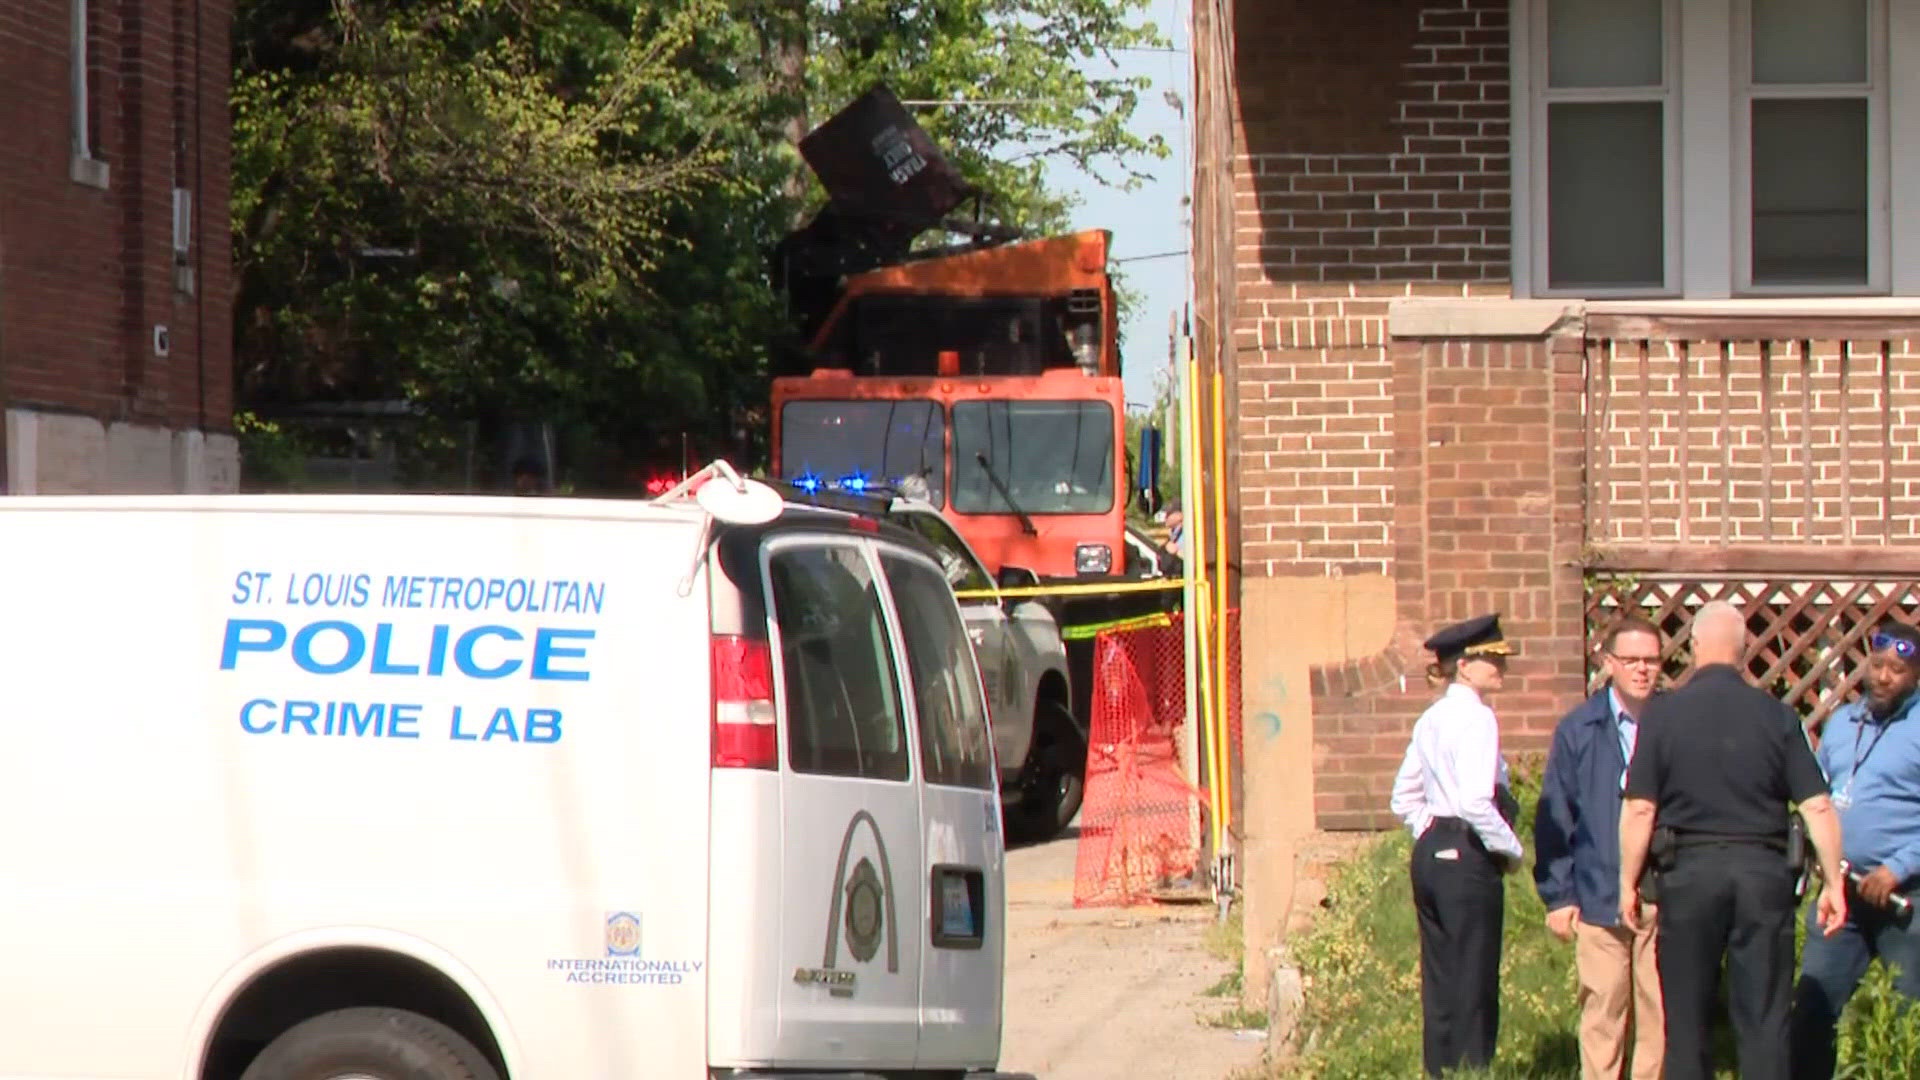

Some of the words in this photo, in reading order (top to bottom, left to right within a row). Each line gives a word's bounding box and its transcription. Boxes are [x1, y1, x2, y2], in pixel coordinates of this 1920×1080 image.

[232, 571, 272, 605] ST.
[285, 573, 371, 607] LOUIS
[381, 575, 606, 614] METROPOLITAN
[219, 618, 597, 682] POLICE
[239, 698, 423, 739] CRIME
[449, 705, 564, 744] LAB
[547, 959, 703, 973] INTERNATIONALLY
[566, 971, 683, 985] ACCREDITED
